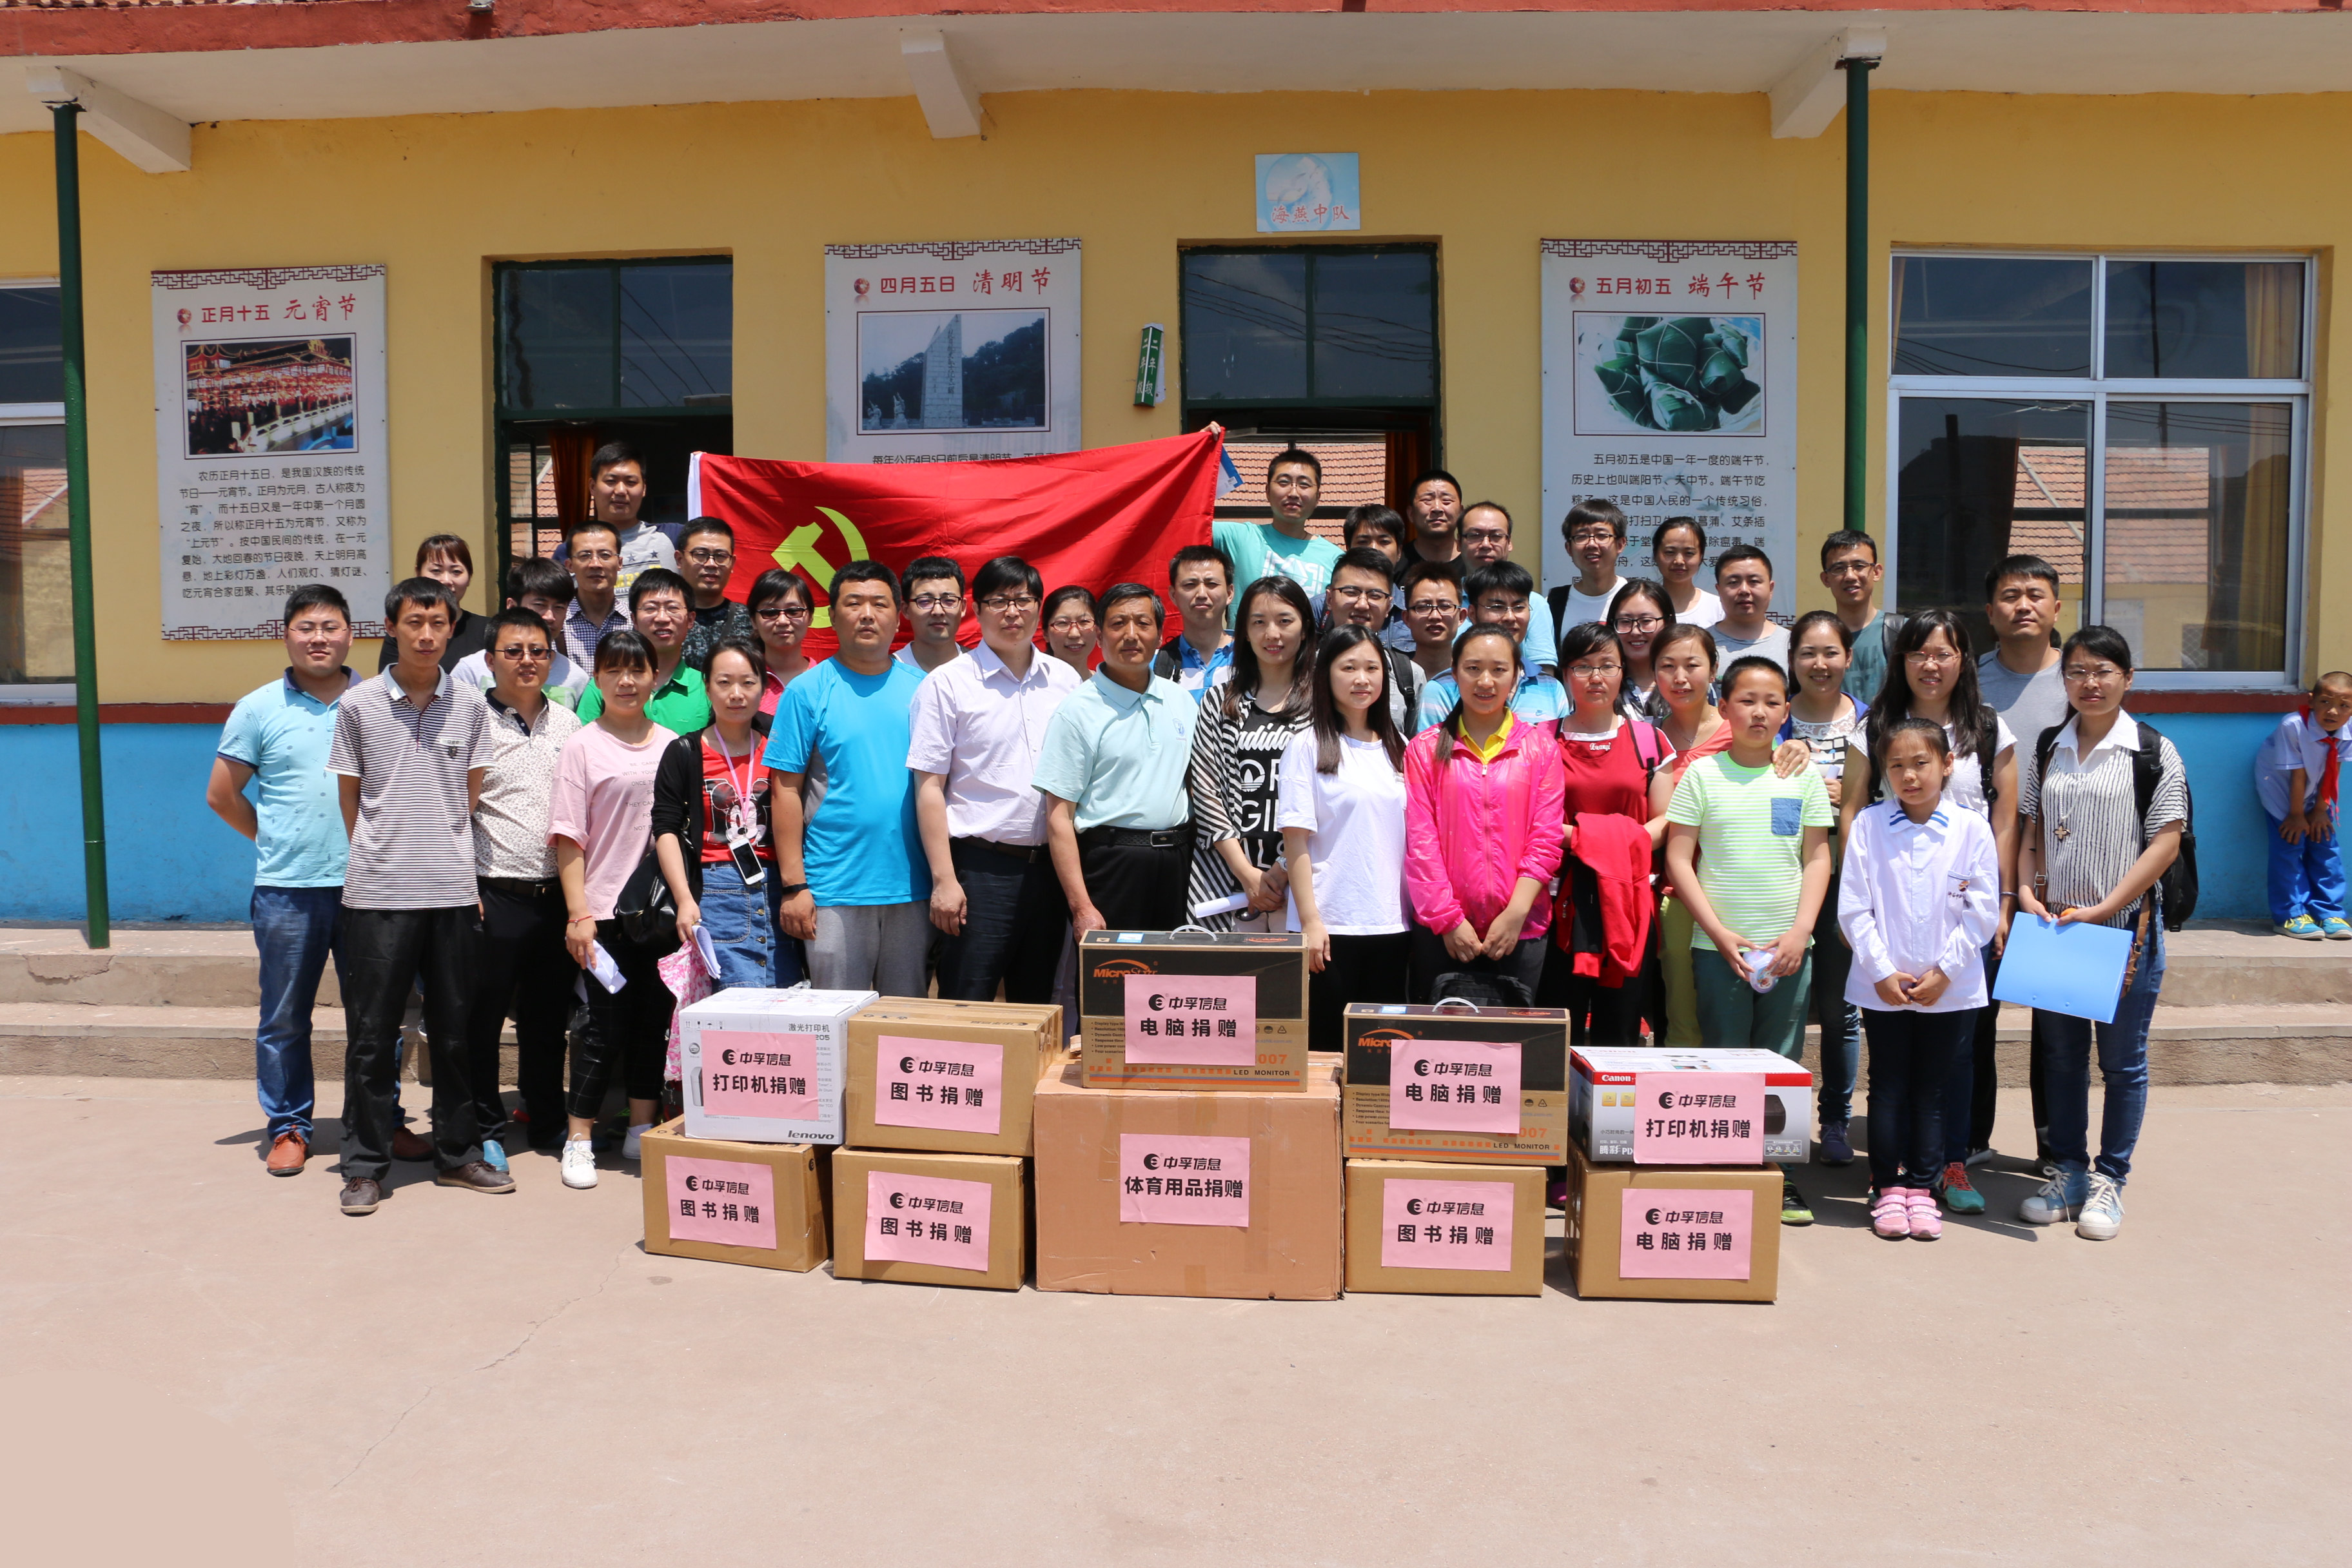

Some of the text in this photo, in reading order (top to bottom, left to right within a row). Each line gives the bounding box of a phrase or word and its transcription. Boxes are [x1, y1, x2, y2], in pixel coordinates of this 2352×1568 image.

[1271, 203, 1350, 224] 海燕中队
[881, 267, 1051, 295] 四月五日 清明节
[1596, 272, 1766, 299] 五月初五 端午节
[201, 293, 357, 323] 正月十五 元宵节
[1168, 996, 1227, 1011] 中孚信息
[789, 1023, 830, 1033] 激光打印机
[1141, 1017, 1237, 1038] 电脑捐赠
[739, 1052, 792, 1067] 中孚信息
[919, 1060, 974, 1077] 中孚信息
[1434, 1062, 1492, 1077] 中孚信息
[712, 1073, 806, 1095] 打印机捐赠
[1406, 1083, 1502, 1104] 电脑捐赠
[890, 1082, 983, 1107] 图书捐赠
[1678, 1094, 1736, 1108] 中孚信息
[788, 1130, 834, 1140] lenovo
[1646, 1119, 1750, 1139] 打印机捐赠
[1163, 1156, 1222, 1171] 中孚信息
[702, 1179, 749, 1195] 中孚信息
[1124, 1176, 1243, 1199] 体育用品捐赠
[680, 1199, 759, 1224] 图书捐赠
[908, 1197, 963, 1214] 中孚信息
[1426, 1201, 1485, 1216] 中孚信息
[1665, 1211, 1723, 1224] 中孚信息
[881, 1217, 972, 1244] 图书捐赠
[1398, 1224, 1494, 1245] 图书捐赠
[1636, 1232, 1732, 1251] 电脑捐赠
